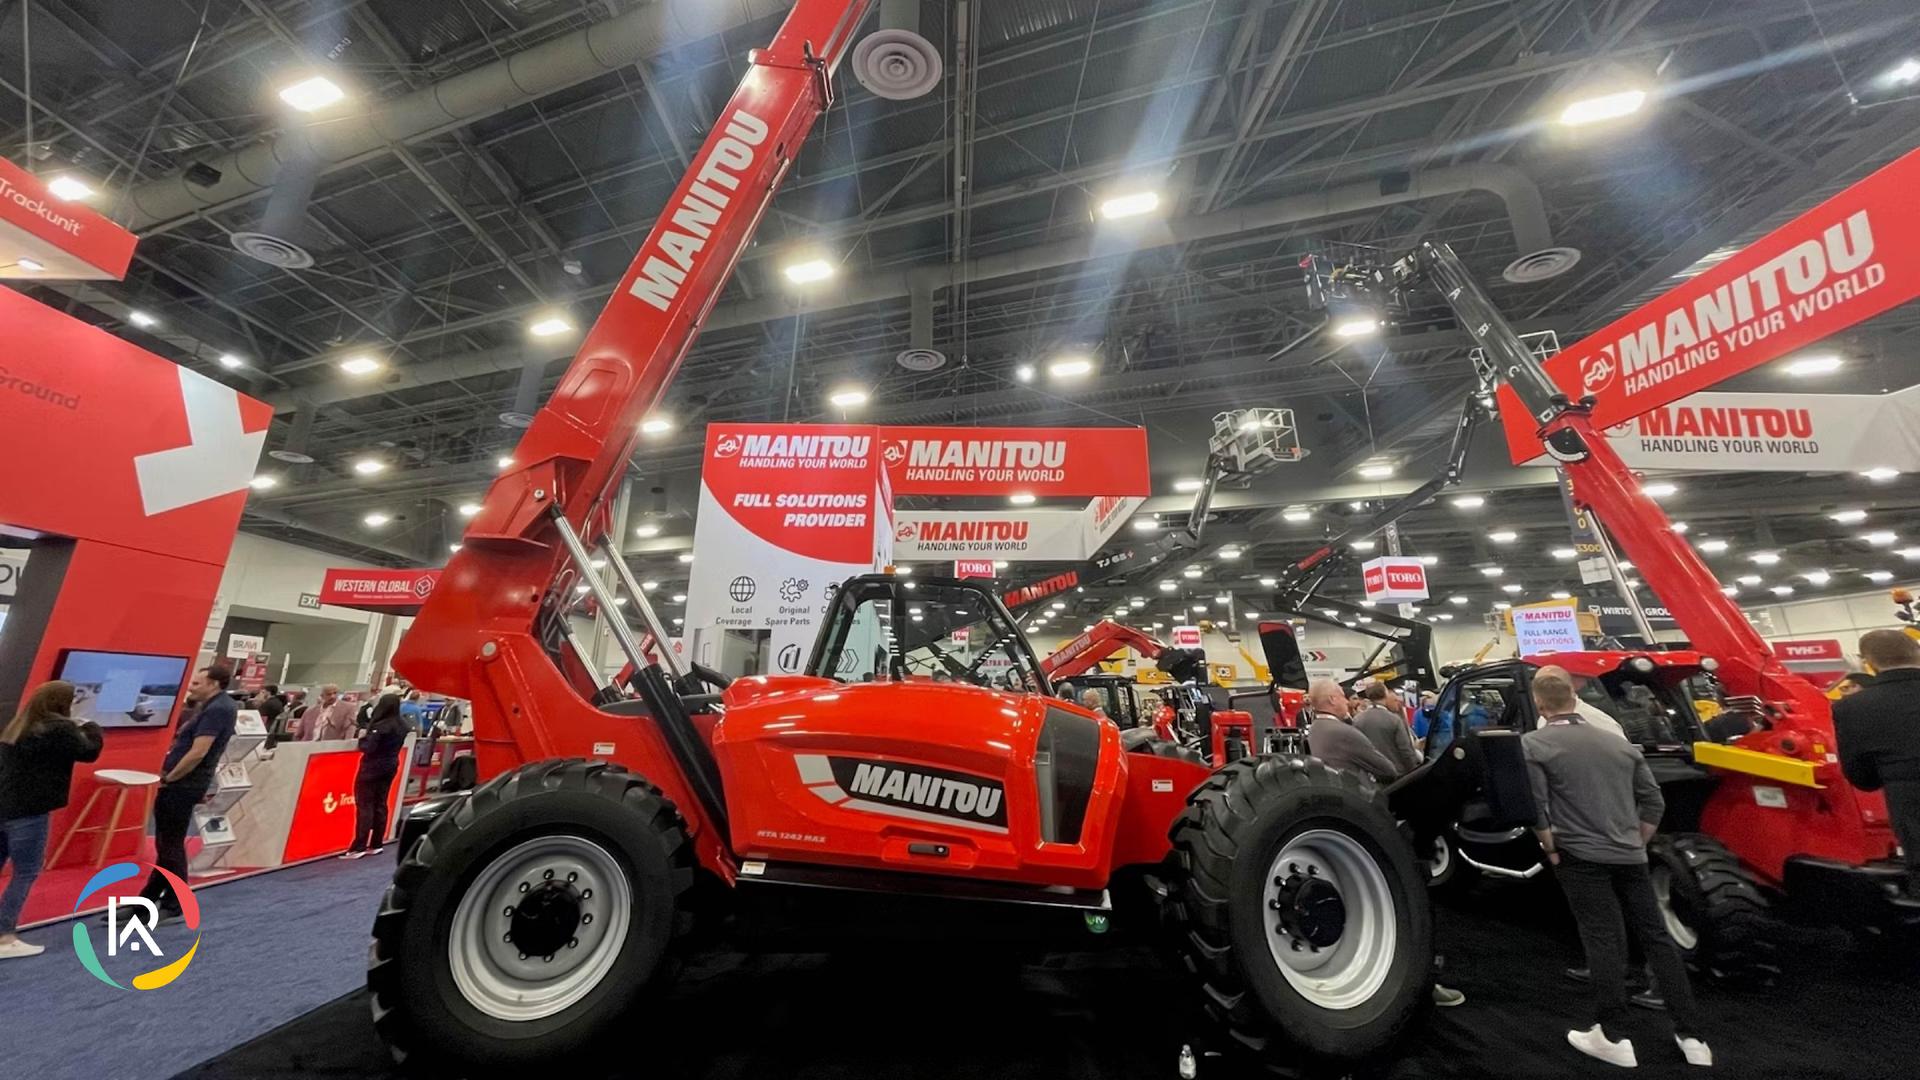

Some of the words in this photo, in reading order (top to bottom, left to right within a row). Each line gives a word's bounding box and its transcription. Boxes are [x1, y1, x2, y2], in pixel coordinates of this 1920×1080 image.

[0, 176, 81, 236] Trackunit
[629, 109, 769, 312] MANITOU
[1619, 209, 1875, 377] MANITOU
[1624, 344, 1720, 397] HANDLING
[1723, 310, 1785, 353] YOUR
[1789, 263, 1886, 323] WORLD
[1637, 407, 1814, 438] MANITOU
[742, 435, 871, 458] MANITOU
[1641, 439, 1718, 453] HANDLING
[1724, 440, 1763, 453] YOUR
[1765, 441, 1819, 454] WORLD
[909, 440, 1067, 468] MANITOU
[739, 458, 795, 469] HANDLING
[798, 458, 826, 469] YOUR
[829, 459, 868, 469] WORLD
[906, 469, 974, 481] HANDLING
[979, 469, 1013, 481] YOUR
[1017, 470, 1065, 482] WORLD
[733, 494, 771, 507] FULL
[776, 494, 867, 508] SOLUTIONS
[784, 513, 866, 527] PROVIDER
[920, 521, 1029, 541] MANITOU
[917, 541, 965, 551] HANDLING
[967, 542, 992, 551] YOUR
[994, 542, 1028, 551] WORLD
[959, 563, 992, 573] TORO
[1389, 573, 1421, 583] TORO
[334, 579, 378, 592] WESTERN
[378, 580, 410, 593] GLOBAL
[1004, 571, 1078, 608] MANITOU
[731, 606, 753, 614] Local
[779, 606, 810, 616] Original
[1525, 610, 1571, 620] MANITOU
[715, 617, 752, 626] Coverage
[765, 617, 788, 626] Spare
[790, 617, 810, 625] Parts
[850, 763, 1002, 818] MANITOU
